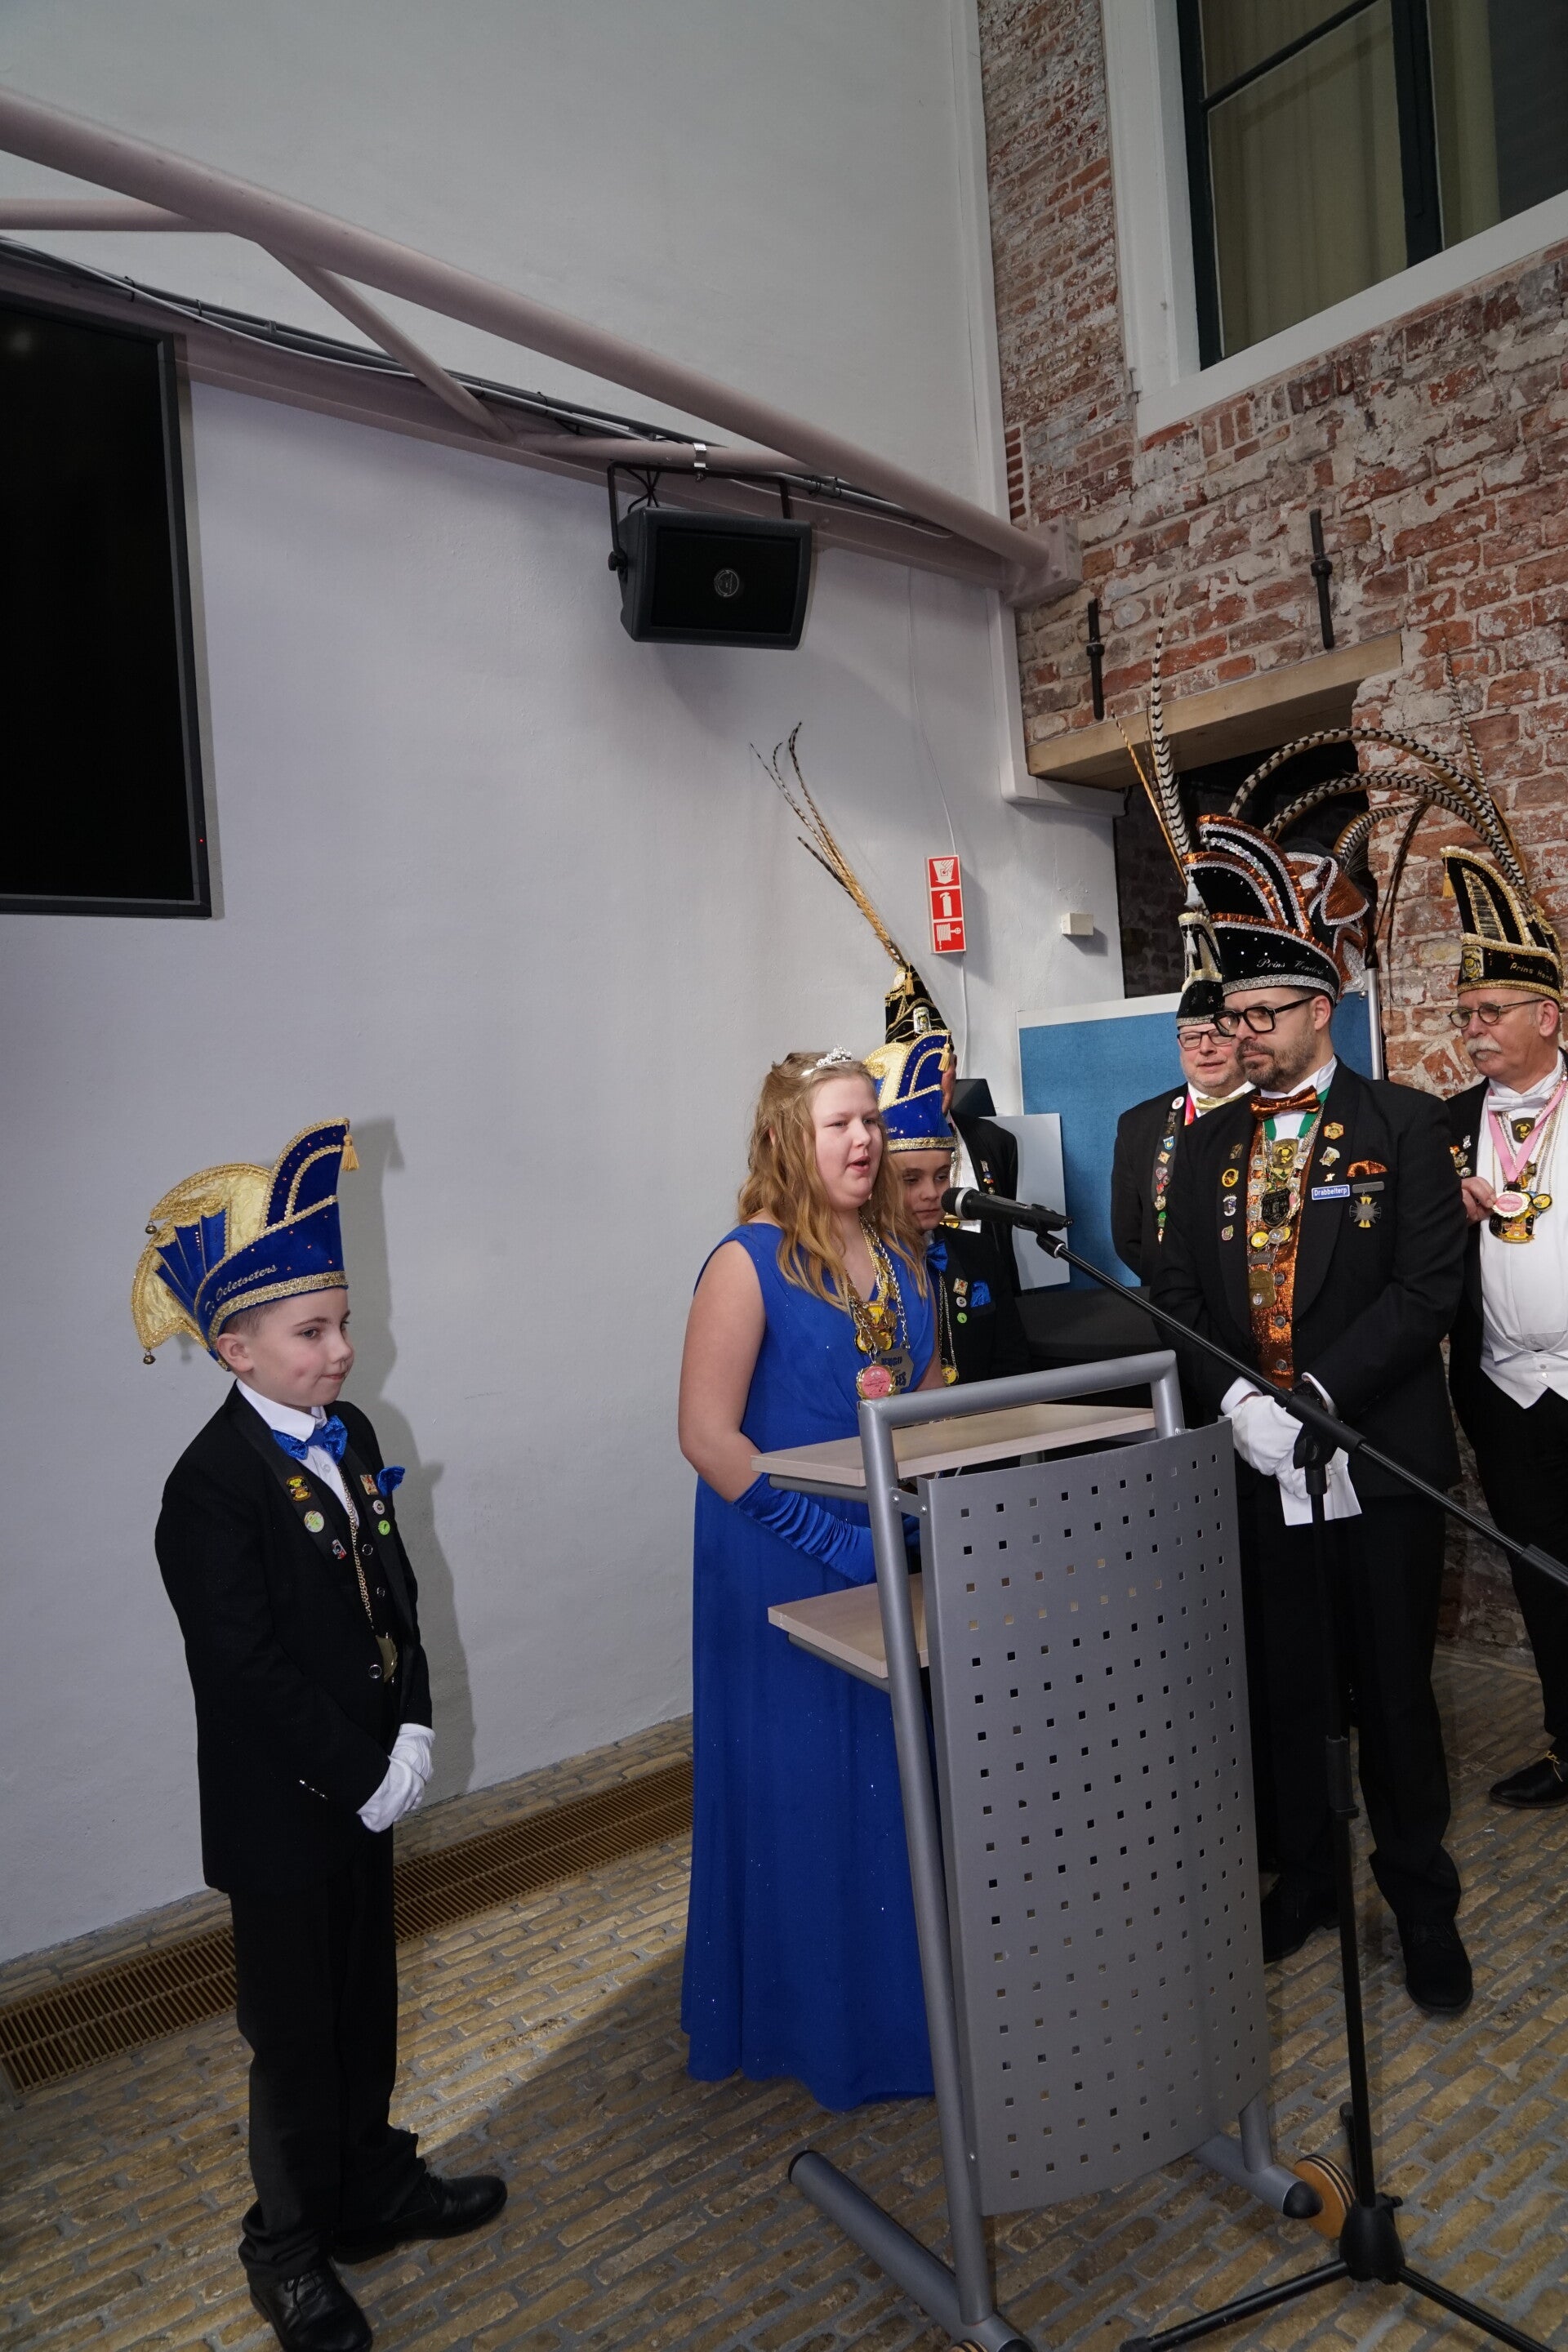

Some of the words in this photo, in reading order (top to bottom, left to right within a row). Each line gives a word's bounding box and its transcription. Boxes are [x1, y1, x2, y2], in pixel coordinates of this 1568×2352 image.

[1256, 958, 1285, 969] Prins
[1509, 962, 1534, 974] Prins
[1314, 1187, 1348, 1196] Drabbelterp
